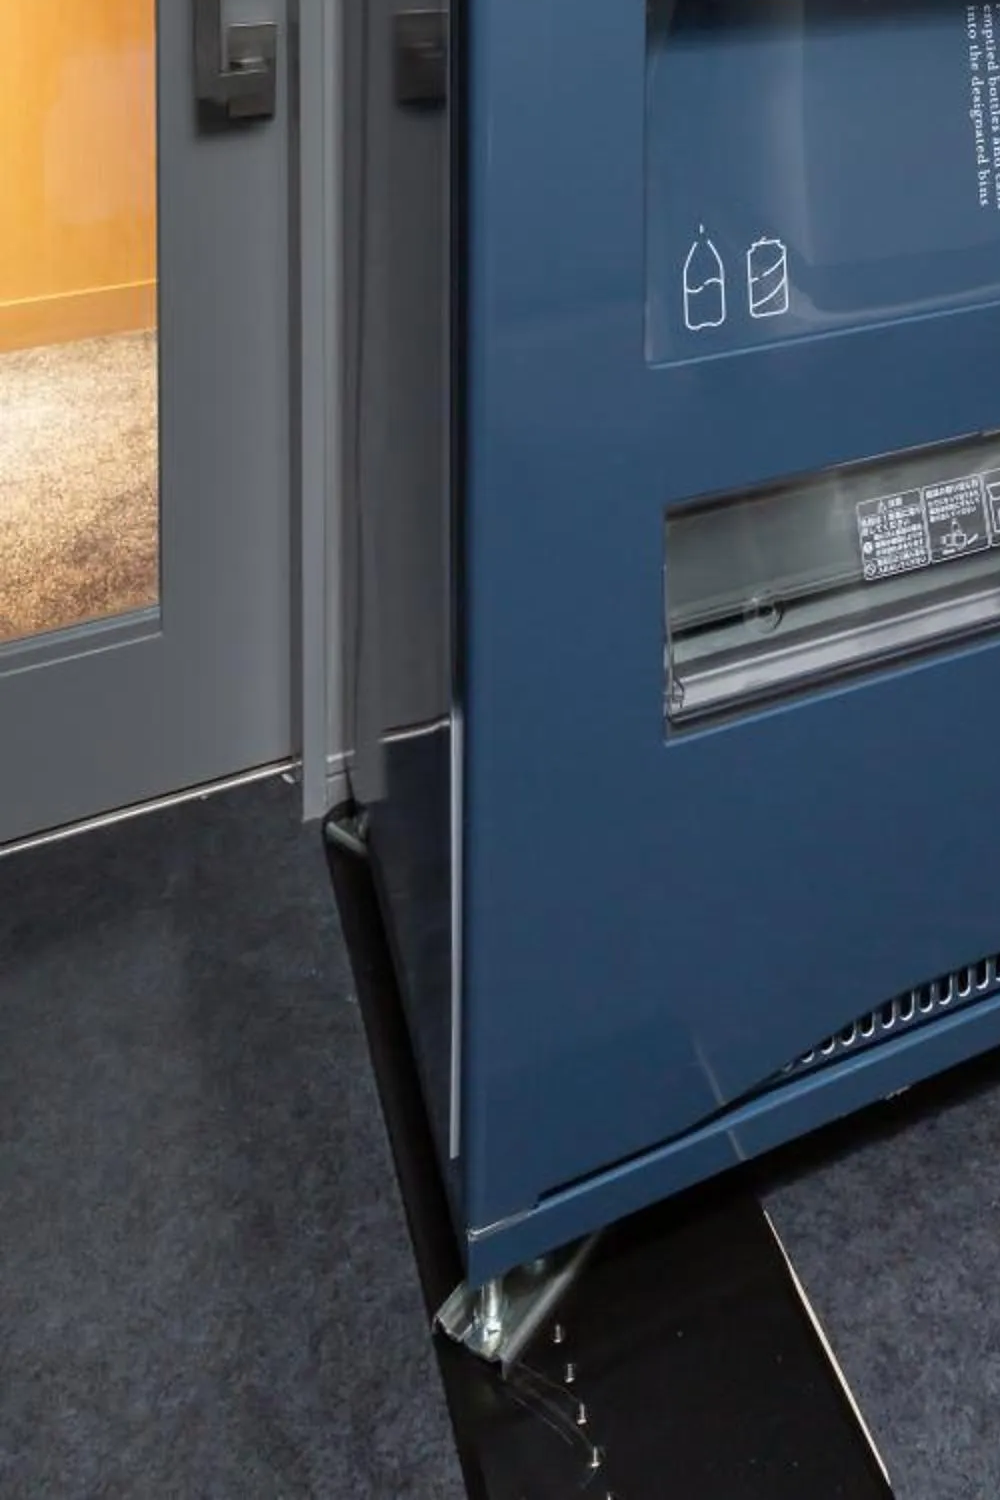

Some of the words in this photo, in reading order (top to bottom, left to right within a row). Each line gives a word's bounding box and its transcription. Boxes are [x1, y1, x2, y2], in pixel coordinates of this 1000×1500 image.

[966, 4, 978, 40] into
[981, 3, 1000, 73] emptied
[968, 45, 983, 71] the
[969, 75, 990, 166] designated
[976, 169, 991, 208] bins
